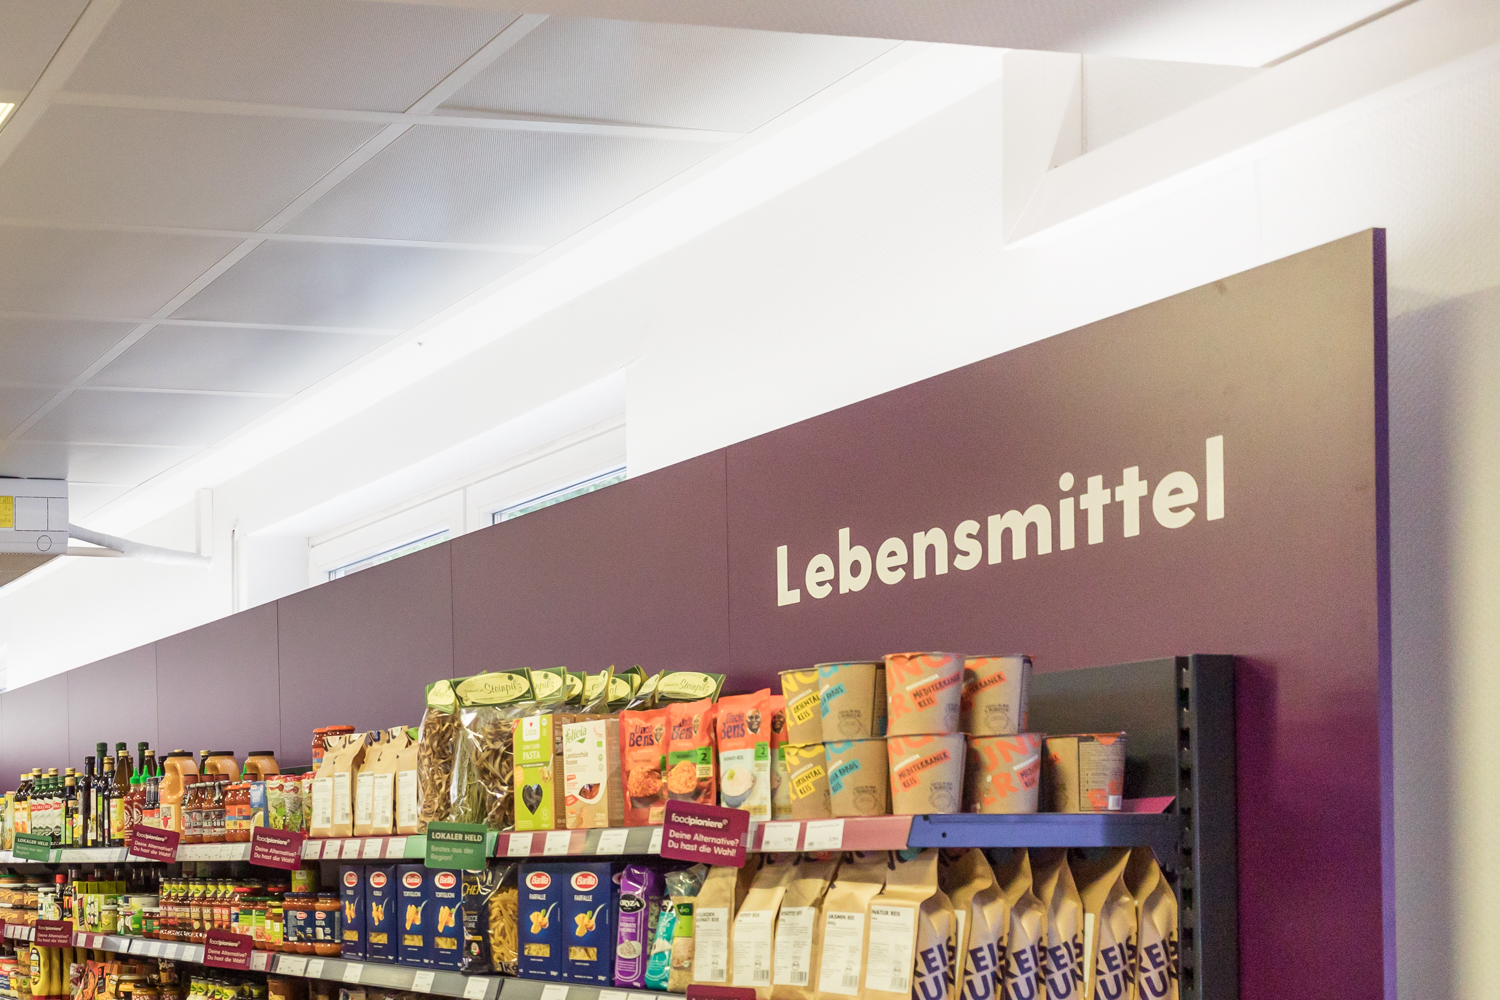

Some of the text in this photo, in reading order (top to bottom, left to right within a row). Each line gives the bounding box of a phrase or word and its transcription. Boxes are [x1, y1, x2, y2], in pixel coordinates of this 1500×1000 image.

[776, 434, 1225, 607] Lebensmittel
[484, 679, 522, 695] Steinpilz
[679, 680, 709, 695] Steinpilz
[523, 751, 541, 760] PASTA
[701, 753, 707, 761] 2
[431, 831, 483, 843] LOKALER HELD
[669, 830, 739, 847] Deine Alternative?
[148, 843, 173, 852] Alternative?
[430, 845, 474, 854] Bestes aus der
[668, 839, 736, 857] Du hast die Wahl!
[270, 848, 296, 857] Alternative?
[430, 852, 453, 862] Region!
[532, 877, 550, 885] Barilla
[577, 877, 596, 885] Barilla
